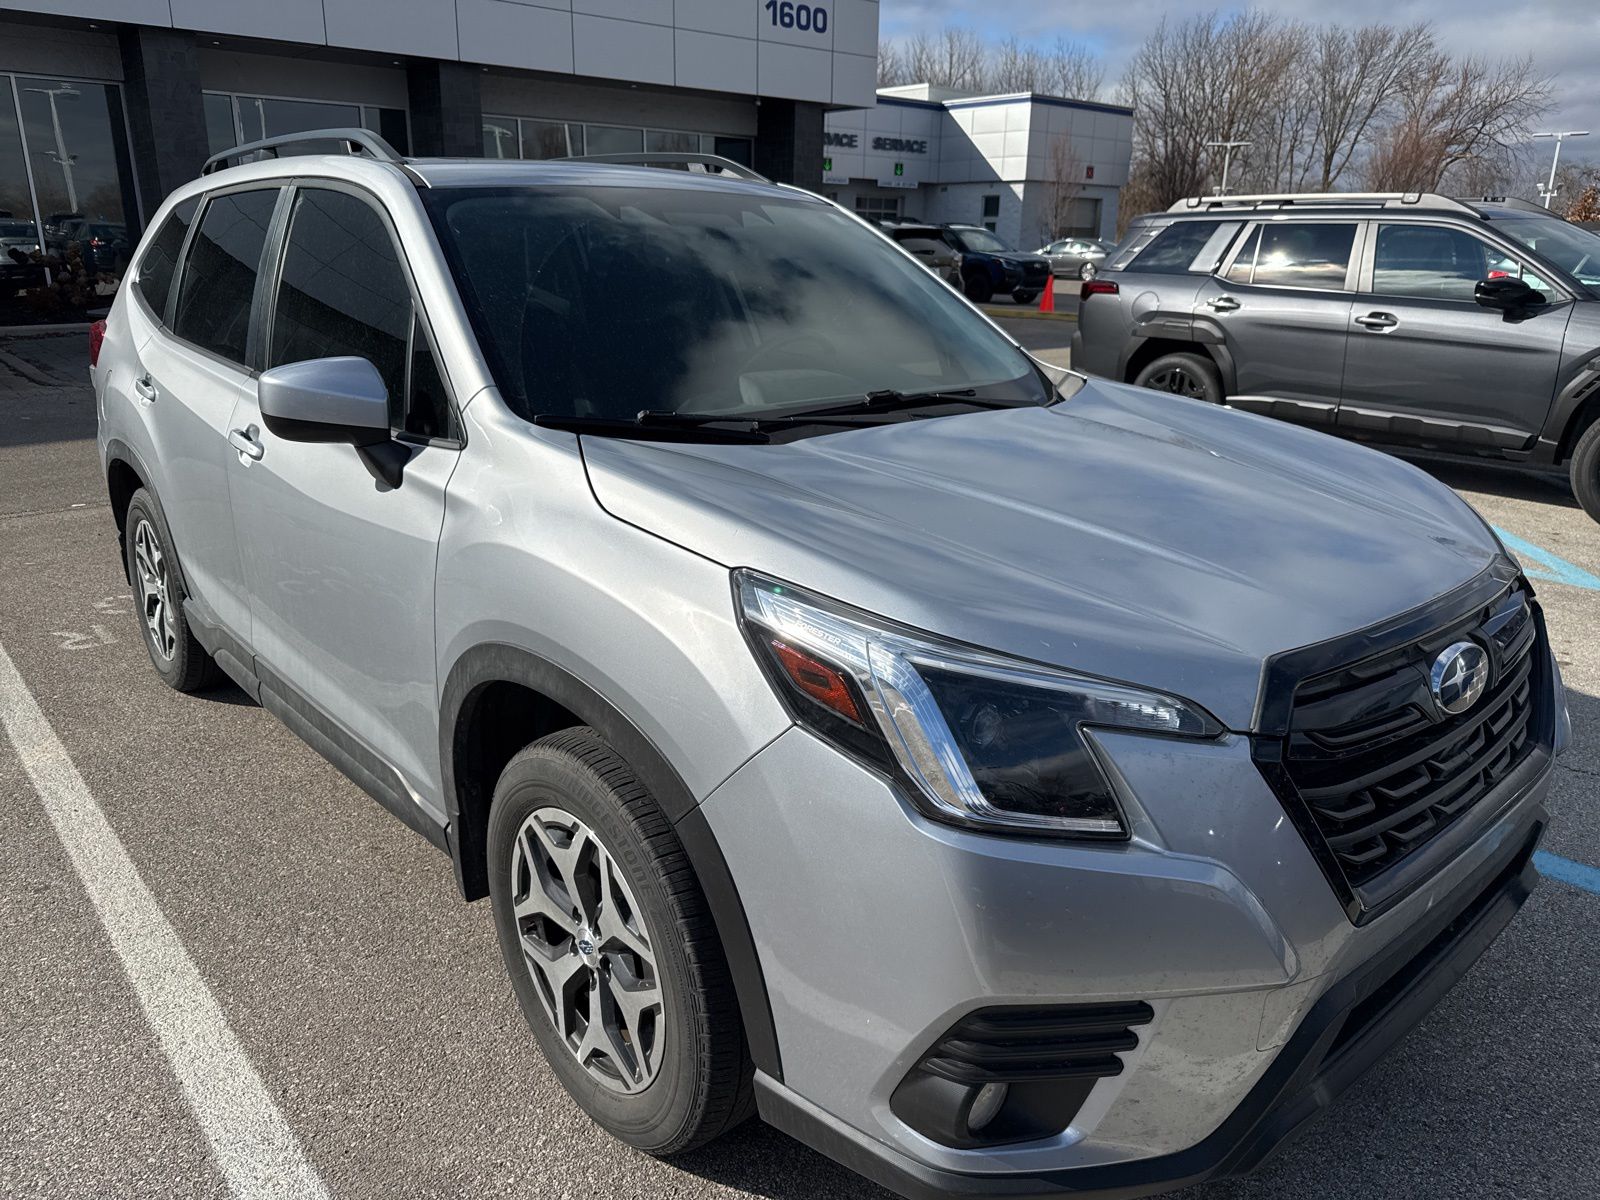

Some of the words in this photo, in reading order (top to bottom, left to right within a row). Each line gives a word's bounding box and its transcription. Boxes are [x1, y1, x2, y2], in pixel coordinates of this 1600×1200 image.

[765, 0, 827, 33] 1600
[872, 137, 927, 154] SERVICE
[796, 621, 841, 645] FORESTER
[555, 769, 654, 896] BRIDGESTONE
